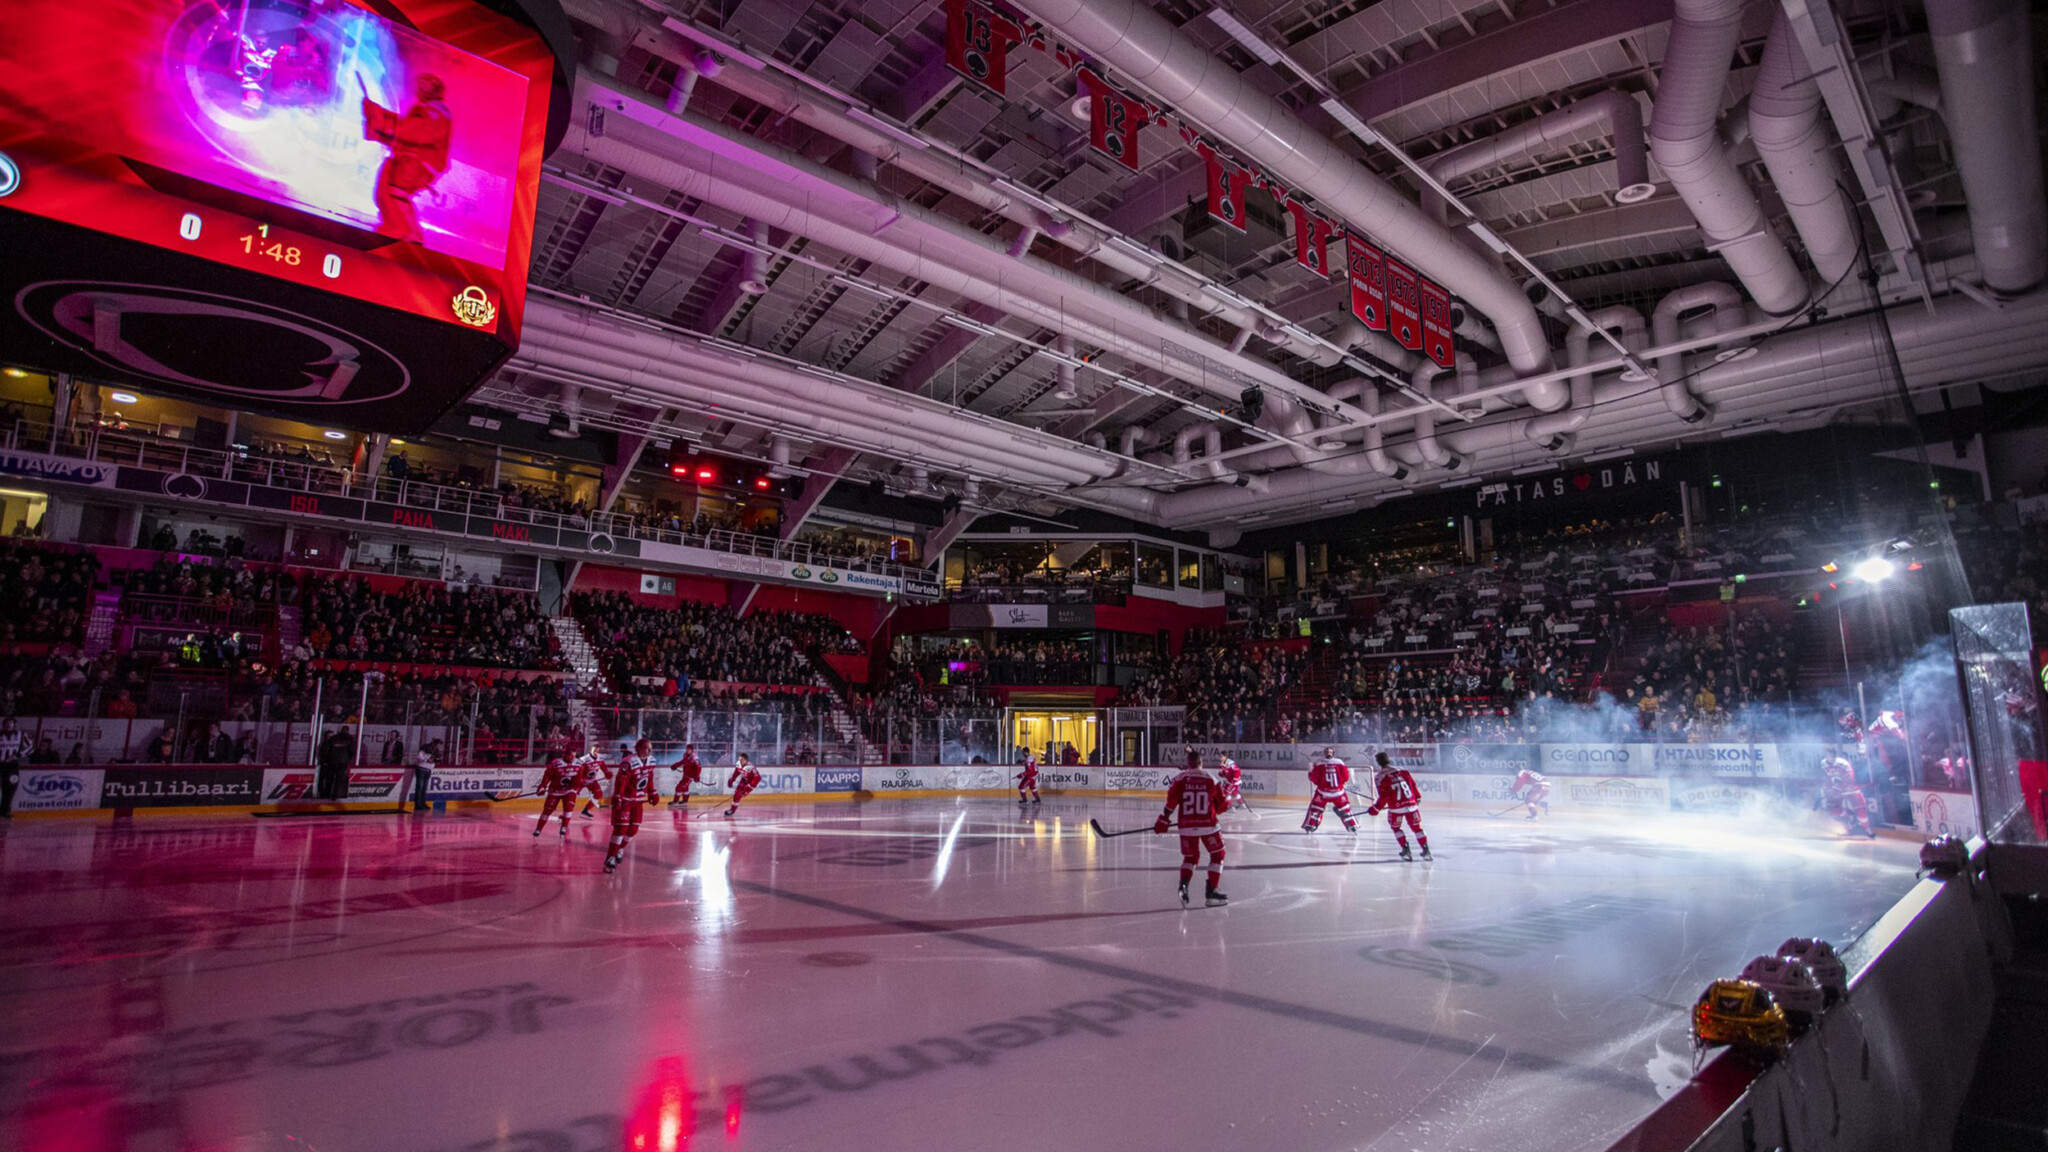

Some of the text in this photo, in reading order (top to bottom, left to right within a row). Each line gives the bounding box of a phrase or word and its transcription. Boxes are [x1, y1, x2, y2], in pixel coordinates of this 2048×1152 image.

[964, 10, 993, 53] 13
[1102, 96, 1126, 135] 12
[180, 212, 202, 241] 0
[258, 224, 269, 238] 1
[240, 235, 301, 265] 1:48
[322, 253, 342, 279] 0
[1351, 250, 1382, 286] 2013
[80, 465, 113, 481] OY
[1476, 461, 1660, 508] PATAS DÄN
[907, 582, 939, 596] Martela
[1654, 748, 1763, 761] AHTAUSKONE
[430, 776, 480, 791] Rauta
[881, 780, 923, 789] RAJUPAJA
[1074, 772, 1088, 786] Oy
[1325, 772, 1339, 788] 41
[1390, 780, 1412, 801] 78
[1472, 790, 1526, 801] RAJUPAJ
[1182, 791, 1209, 815] 20
